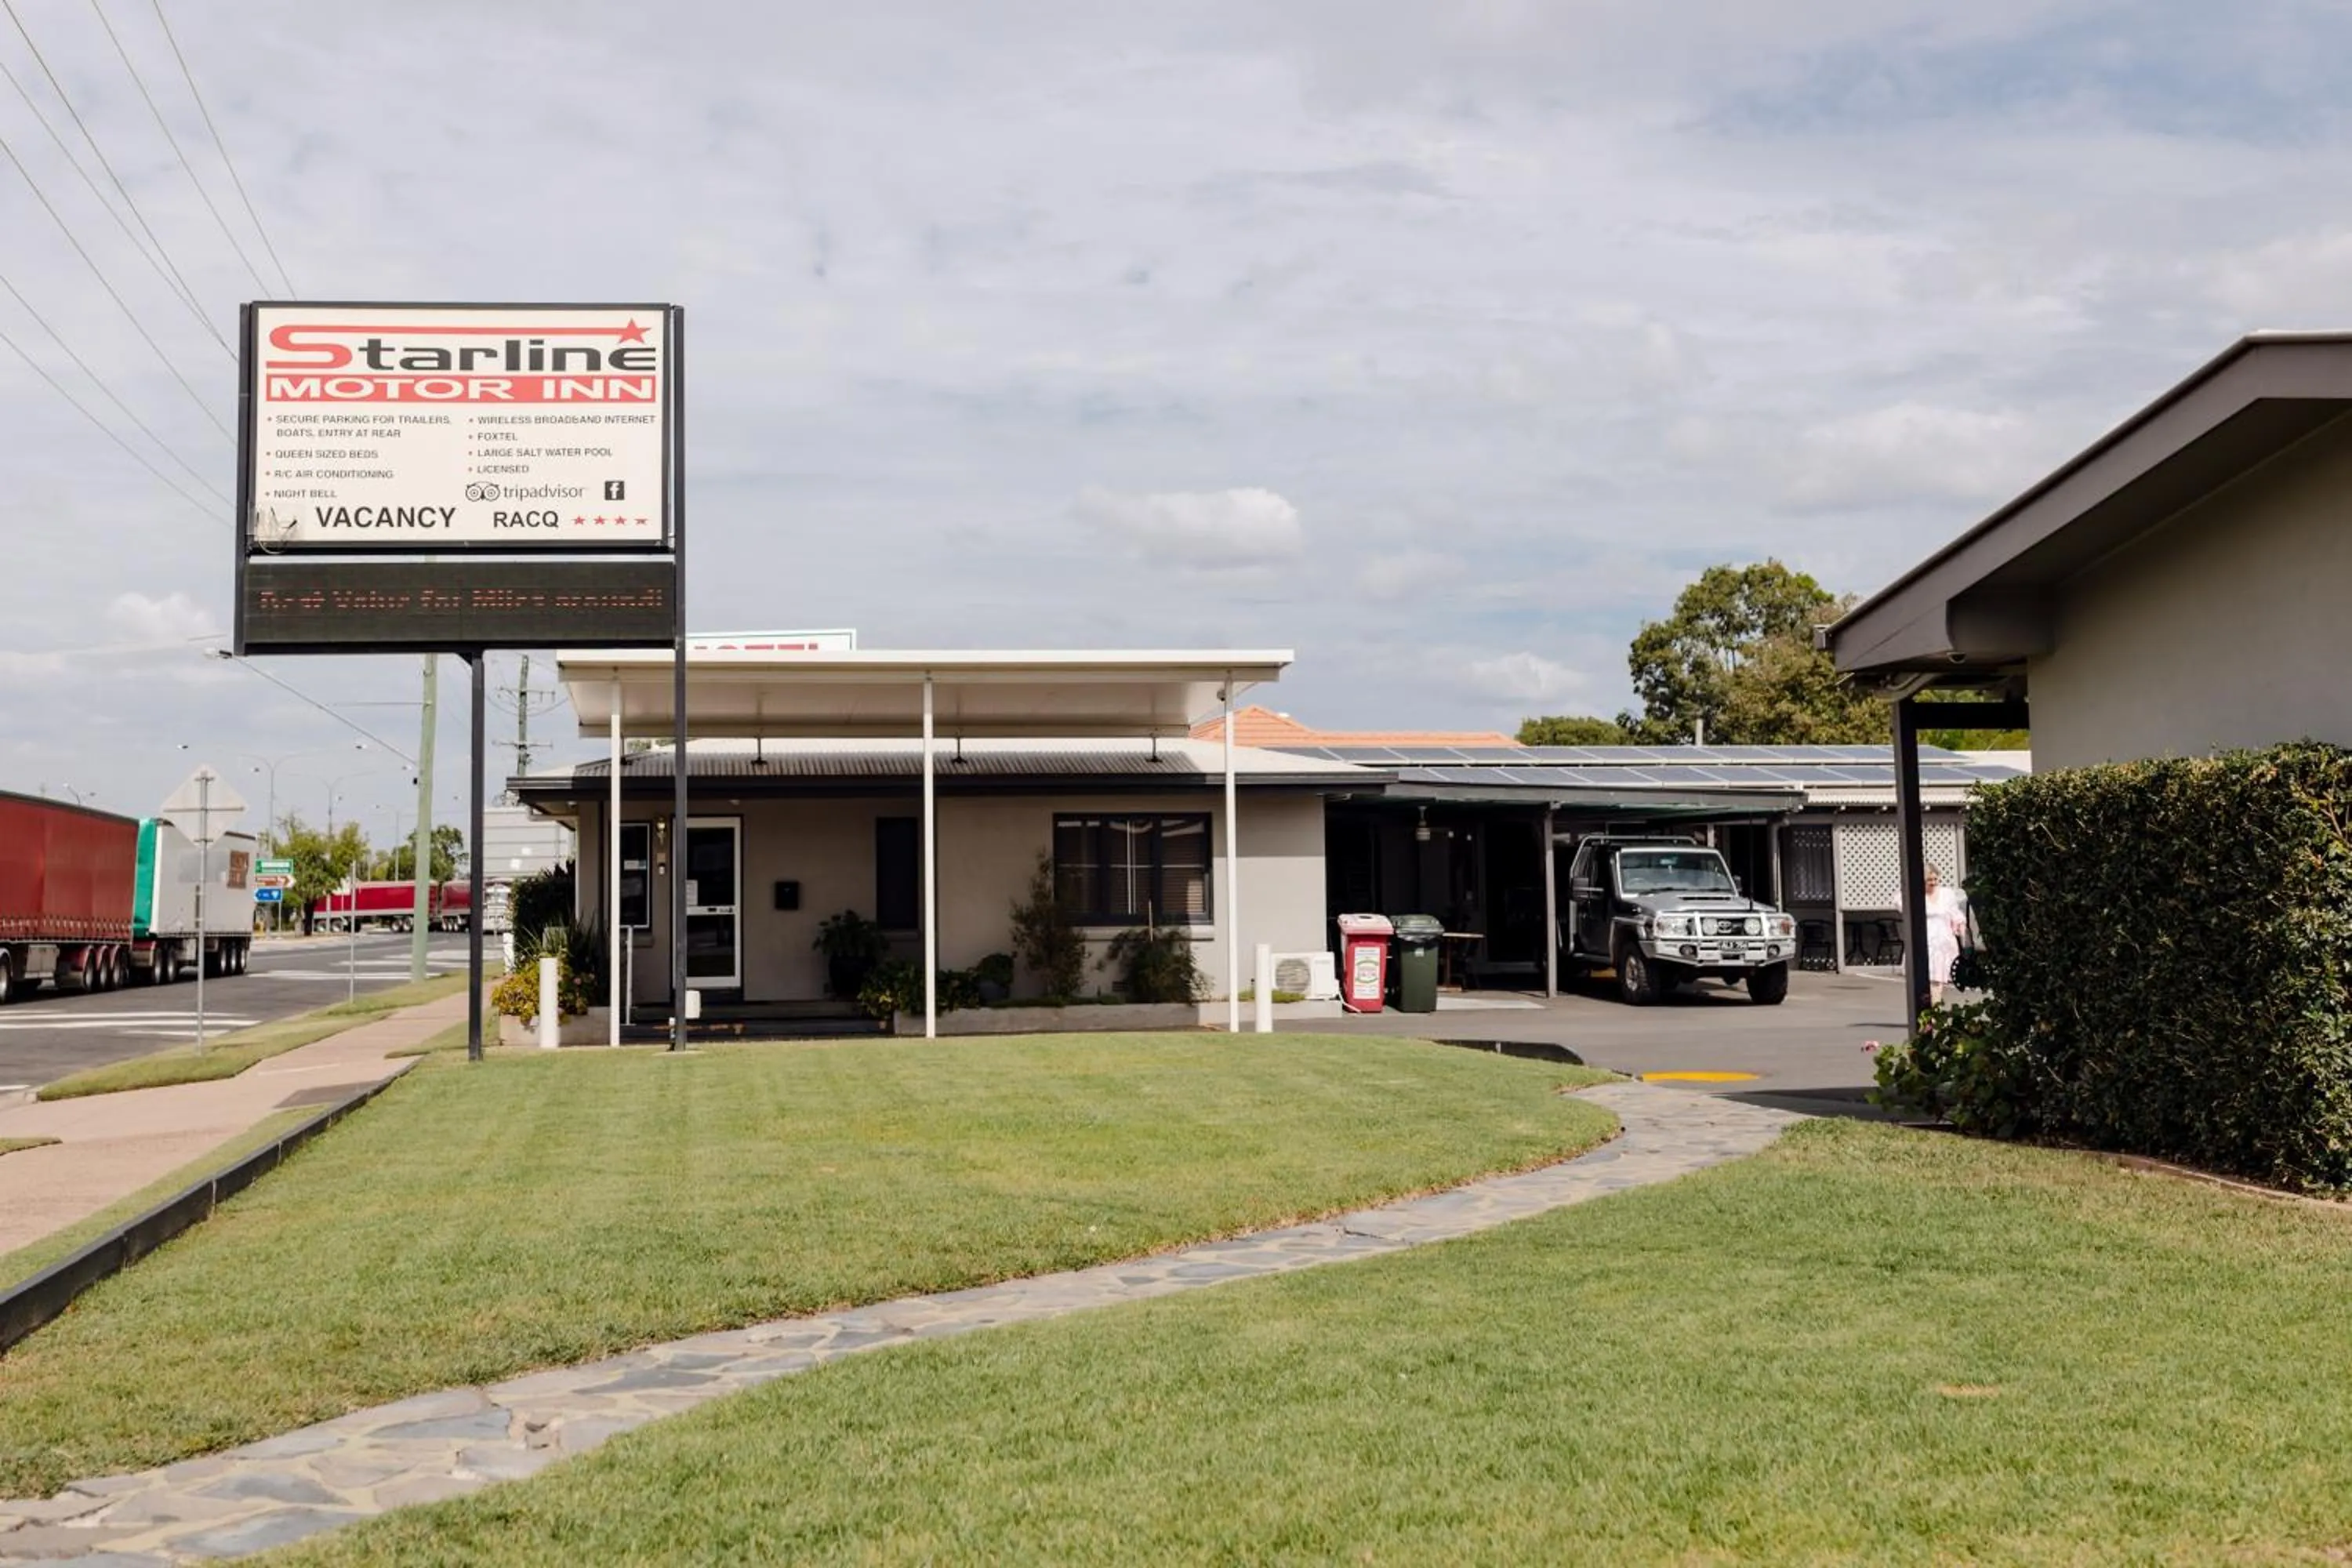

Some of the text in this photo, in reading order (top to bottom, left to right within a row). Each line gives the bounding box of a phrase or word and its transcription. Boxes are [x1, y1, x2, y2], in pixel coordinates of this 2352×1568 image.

[267, 325, 656, 371] Starline
[270, 377, 652, 400] MOTOR INN
[276, 415, 319, 424] SECURE
[322, 415, 370, 424] PARKING
[372, 415, 394, 424] FOR
[477, 415, 656, 424] WIRELESS BROADBAND INTERNET
[318, 428, 353, 437] ENTRY
[355, 428, 368, 437] AT
[372, 429, 401, 437] REAR
[477, 432, 518, 441] FOXTEL
[275, 449, 379, 459] QUEEN SIZED BEDS
[477, 448, 613, 457] LARGE SALT WATER POOL
[477, 465, 529, 474] LICENSED
[296, 470, 313, 478] AIR
[316, 470, 394, 479] CONDITIONING
[274, 489, 307, 499] NIGHT
[503, 484, 586, 501] tripadvisor
[315, 506, 456, 528] VACANCY
[493, 510, 559, 528] RACQ
